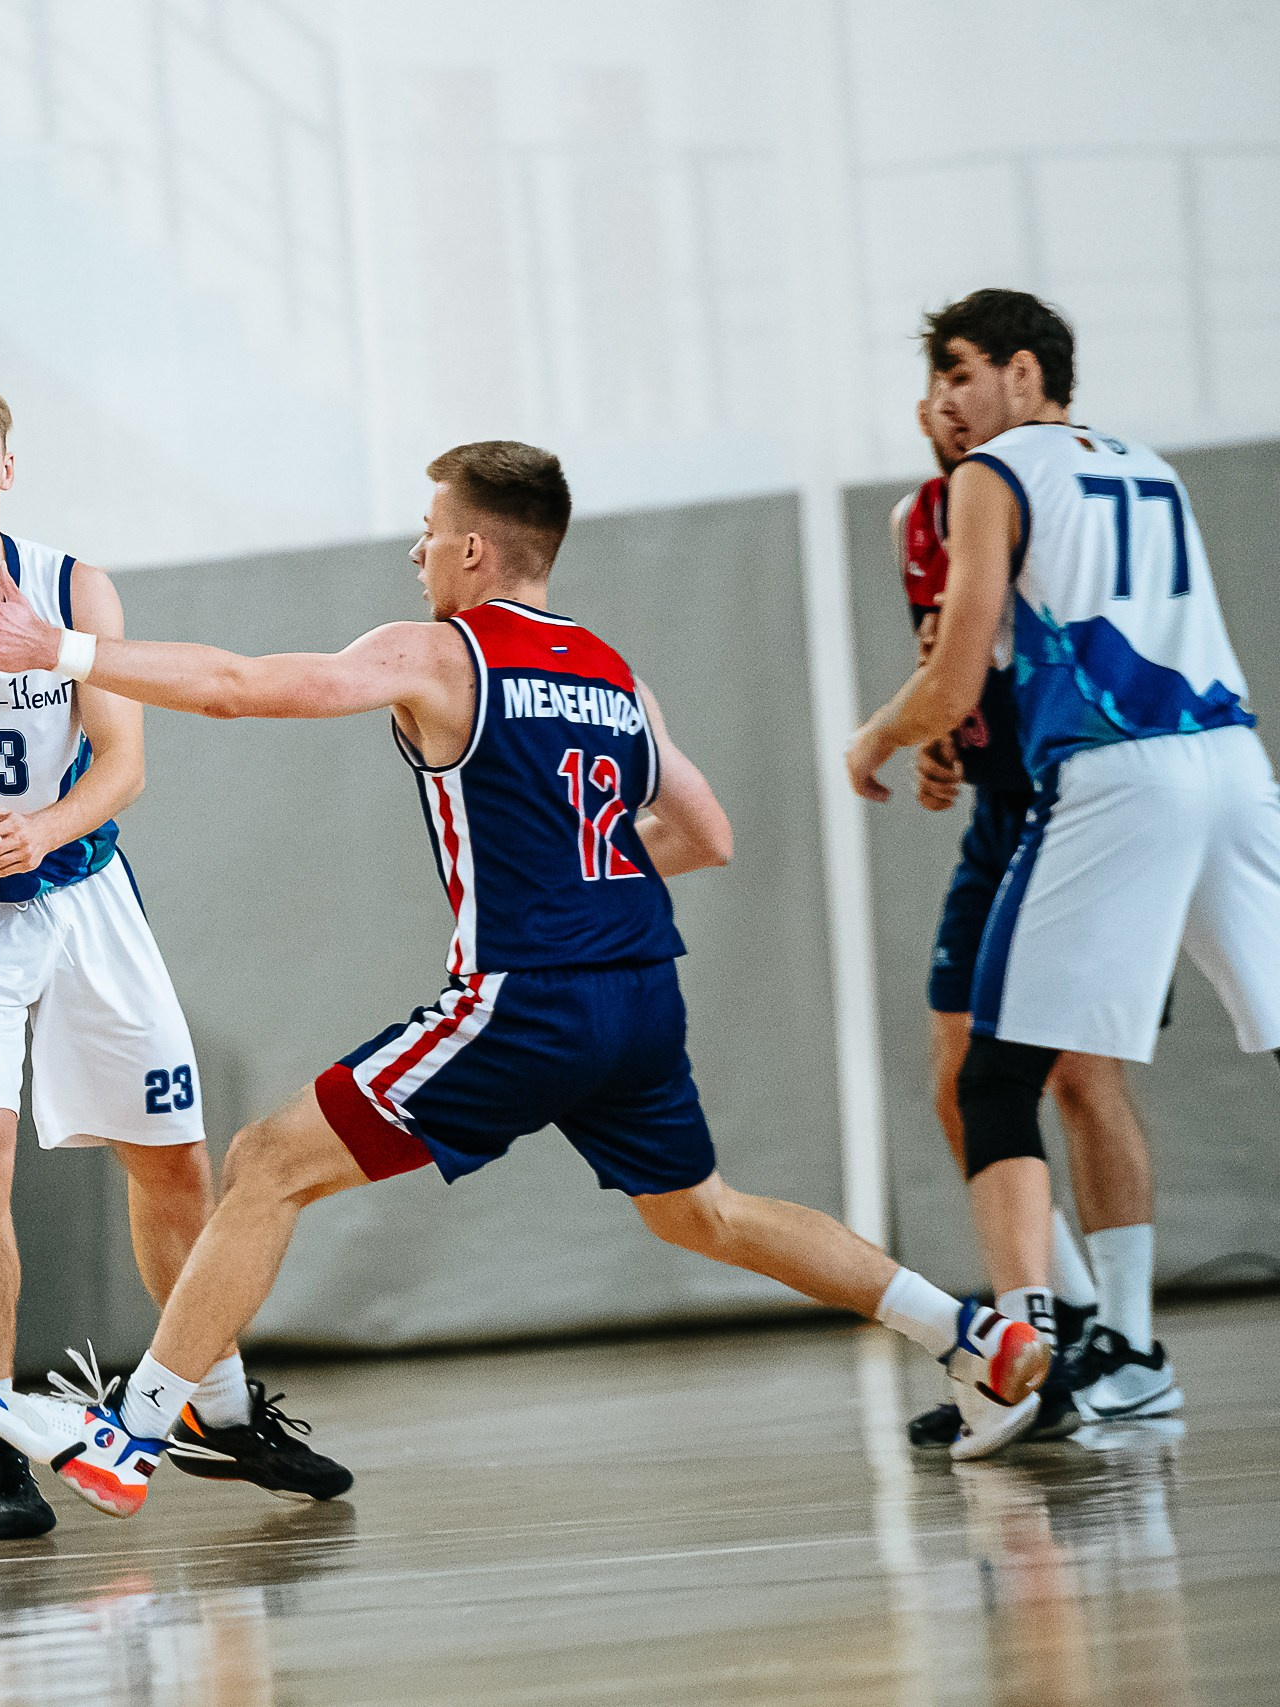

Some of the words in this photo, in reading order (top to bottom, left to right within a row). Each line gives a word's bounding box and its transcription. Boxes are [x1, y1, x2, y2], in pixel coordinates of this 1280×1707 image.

[1073, 472, 1191, 601] 77
[556, 748, 647, 882] 12
[144, 1063, 195, 1115] 23
